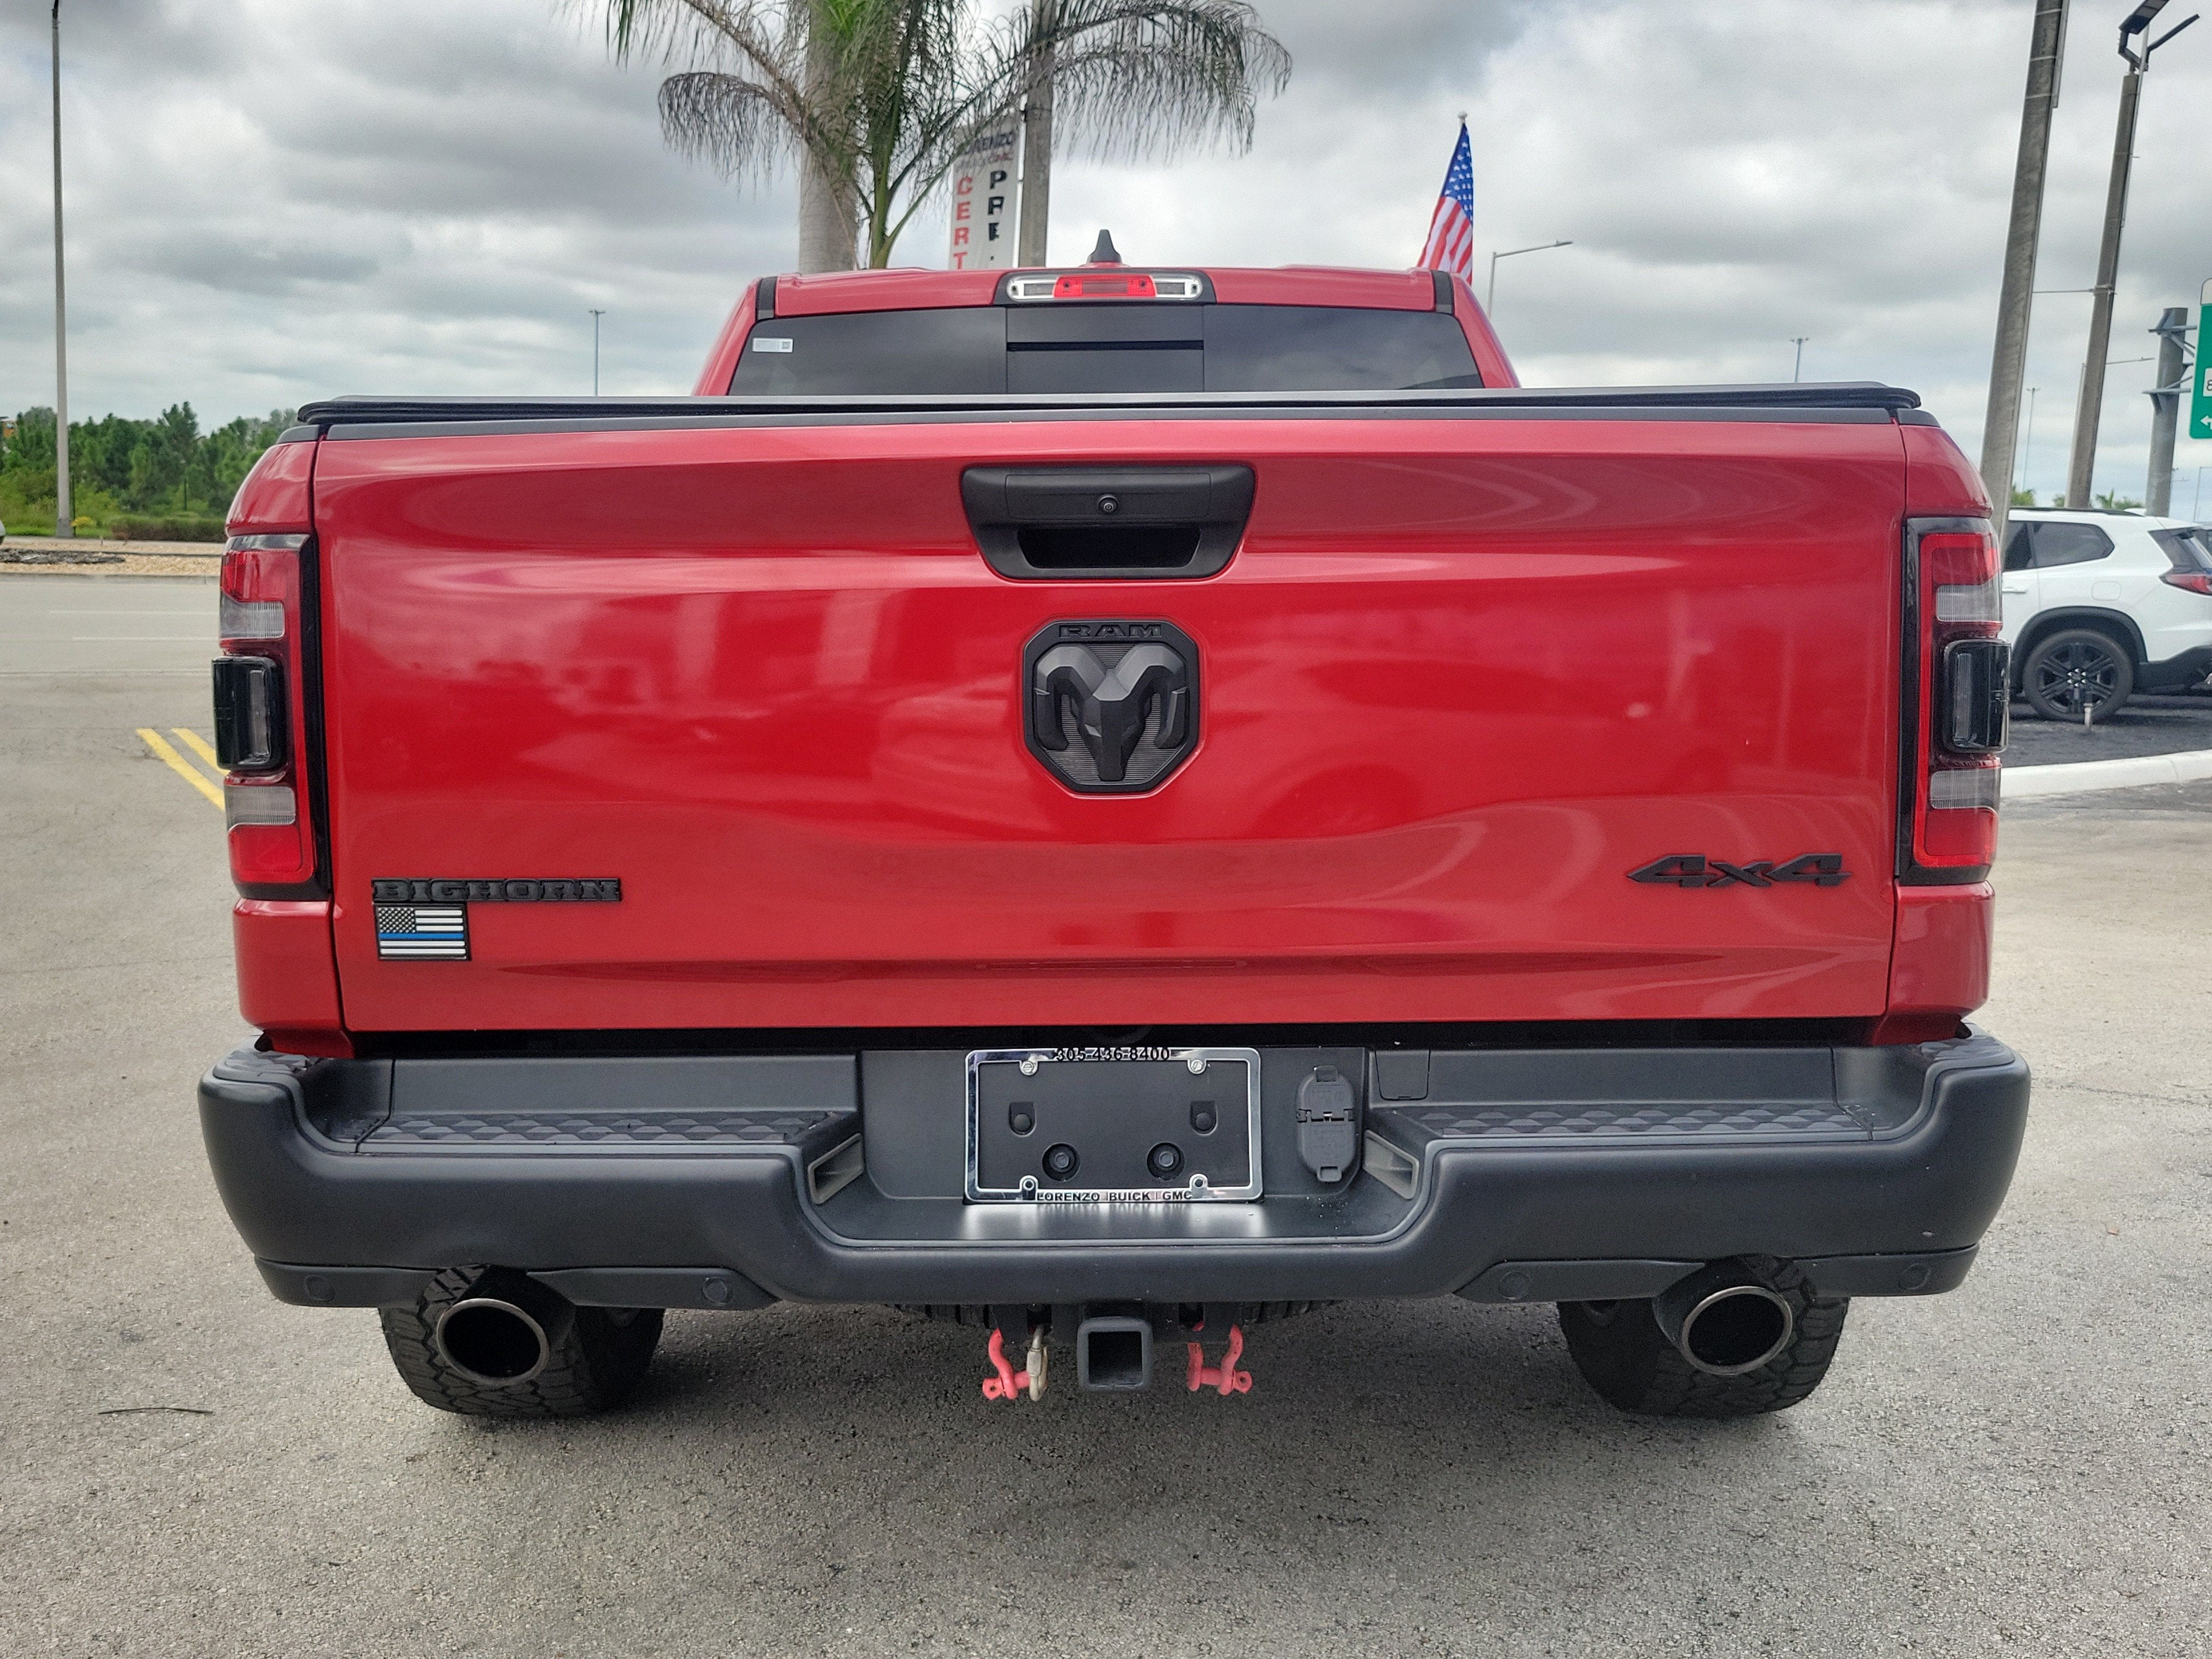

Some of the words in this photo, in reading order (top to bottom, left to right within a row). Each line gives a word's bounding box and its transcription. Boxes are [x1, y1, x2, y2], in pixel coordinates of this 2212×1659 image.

[1059, 624, 1162, 637] RAM
[1054, 1047, 1171, 1061] 305-436-8400
[1037, 1192, 1099, 1201] LORENZO
[1109, 1192, 1150, 1200] BUICK
[1162, 1190, 1192, 1200] GMC
